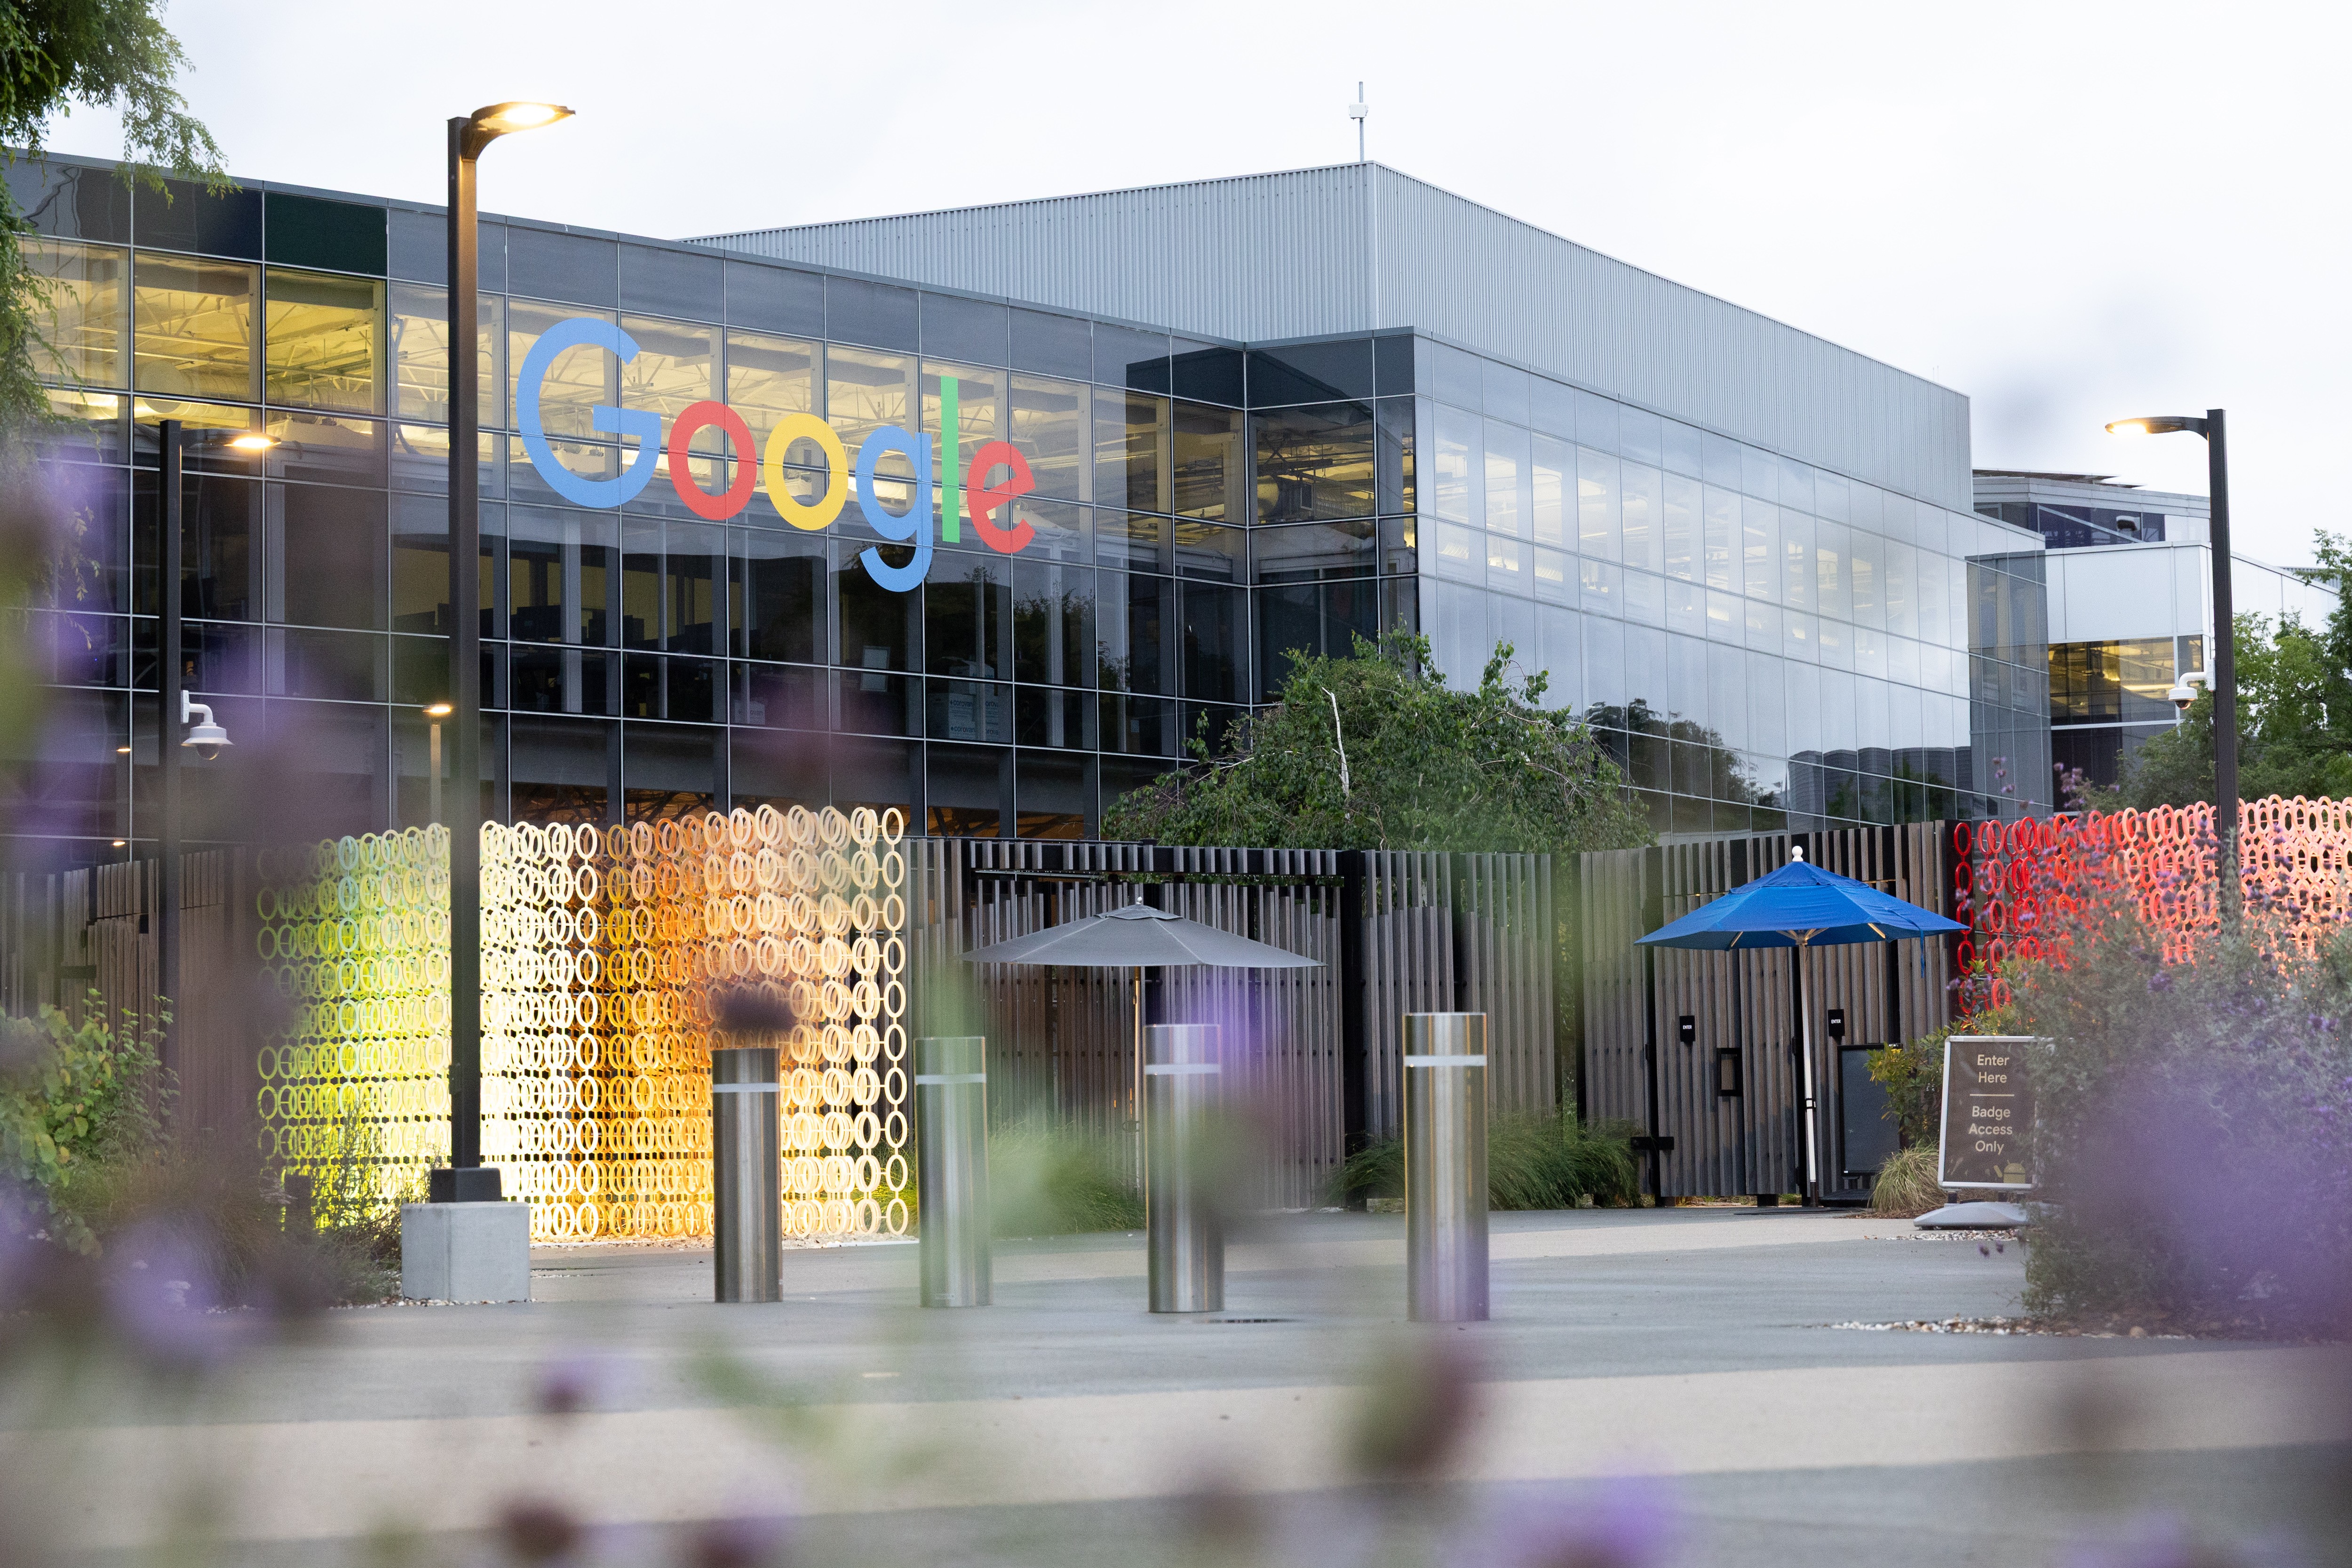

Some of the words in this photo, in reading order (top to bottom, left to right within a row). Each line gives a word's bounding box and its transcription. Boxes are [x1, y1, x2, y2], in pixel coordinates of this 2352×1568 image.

[516, 317, 1035, 592] Google
[1977, 1054, 2010, 1066] Enter
[1978, 1072, 2007, 1083] Here
[1971, 1106, 2010, 1120] Badge
[1968, 1123, 2013, 1135] Access
[1975, 1140, 2004, 1155] Only
